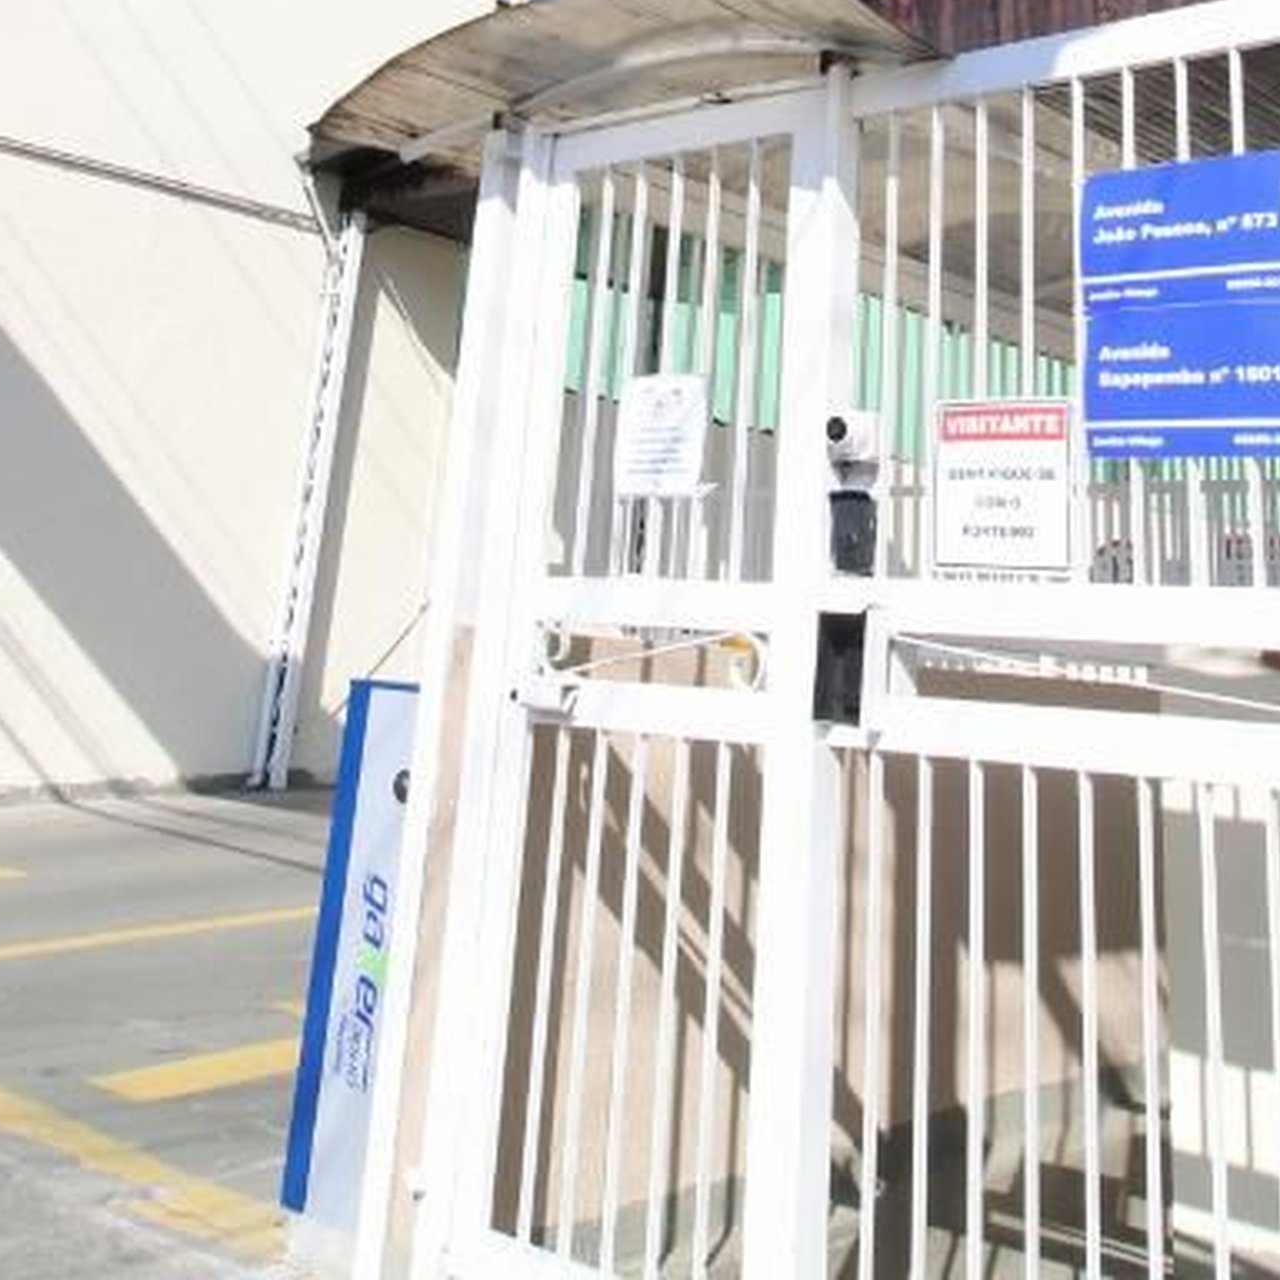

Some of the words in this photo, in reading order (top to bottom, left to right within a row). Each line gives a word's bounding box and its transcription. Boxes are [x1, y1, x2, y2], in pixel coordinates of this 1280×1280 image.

[1092, 199, 1165, 221] Avenida
[1092, 225, 1138, 244] João
[1098, 342, 1171, 363] Avenida
[946, 413, 1060, 436] VISITANTE
